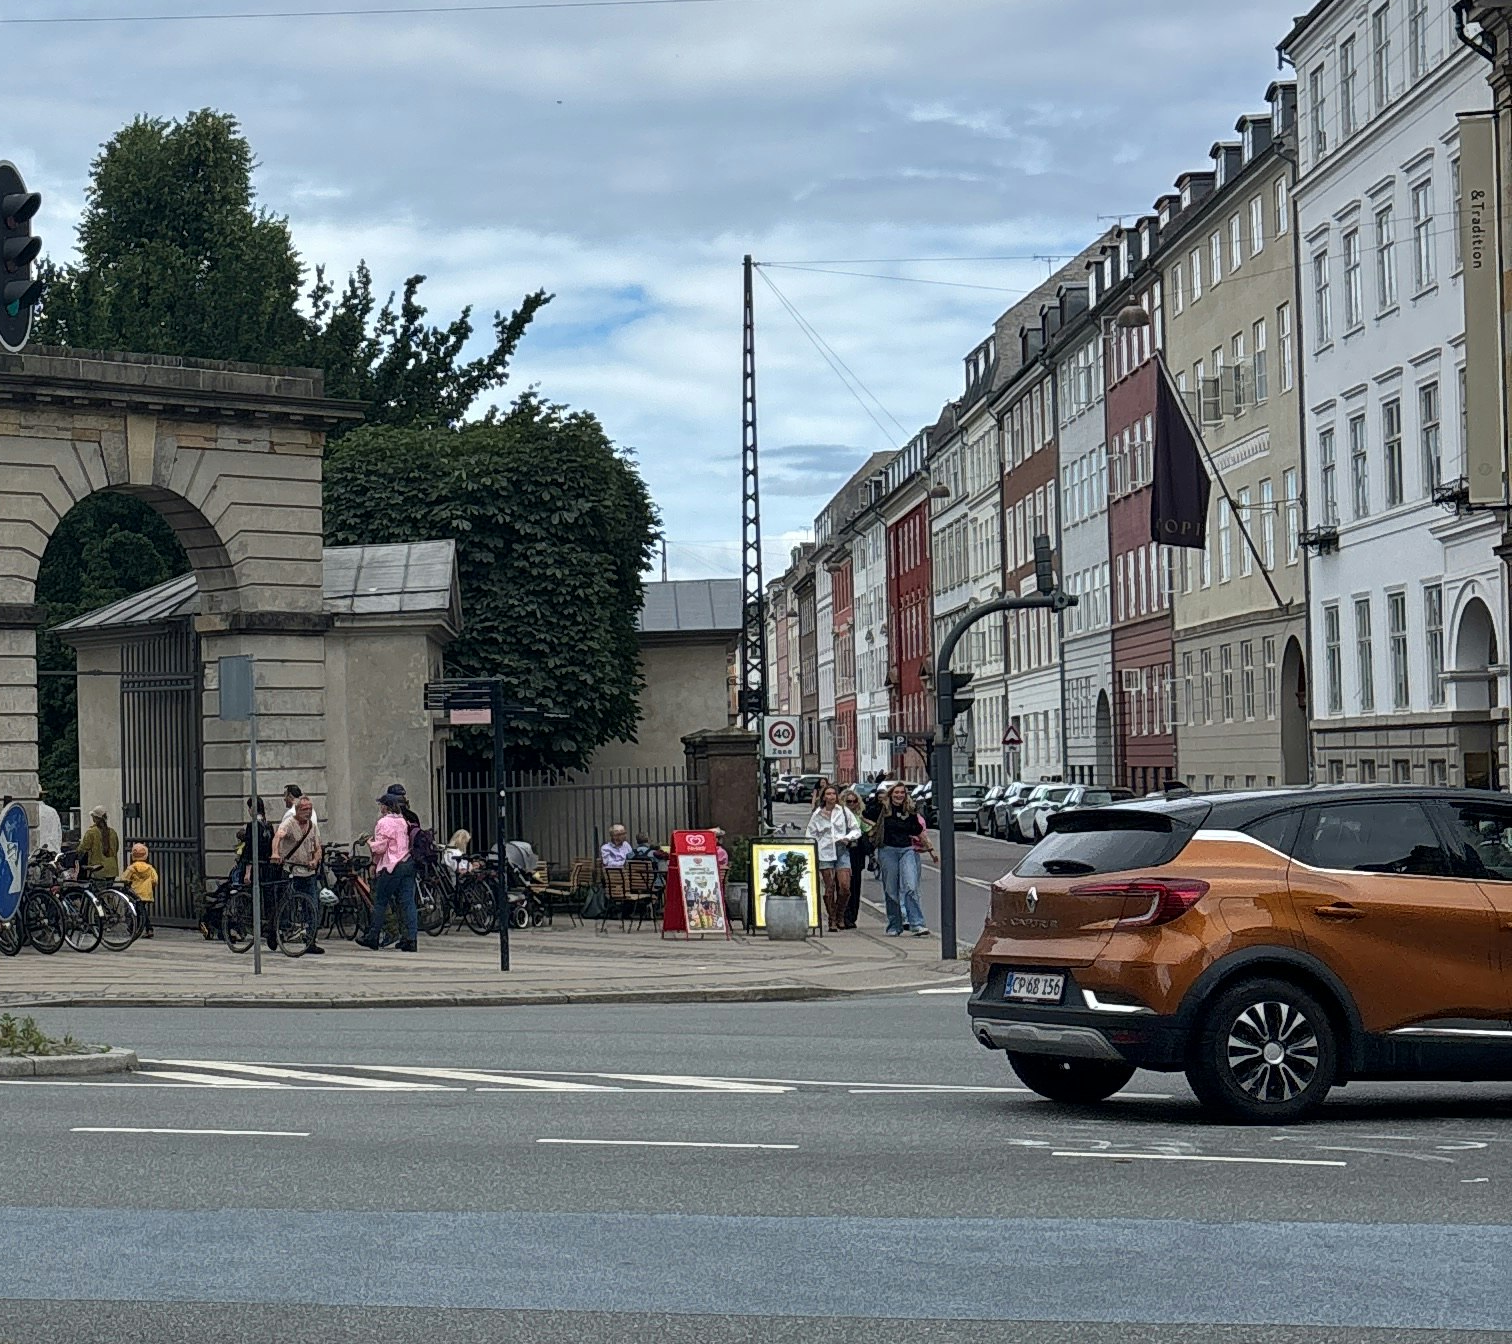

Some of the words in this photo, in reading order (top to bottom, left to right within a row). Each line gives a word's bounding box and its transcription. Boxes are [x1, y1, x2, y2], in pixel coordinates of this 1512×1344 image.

[1470, 189, 1486, 270] &Tradition
[774, 728, 791, 739] 40
[1012, 976, 1026, 994] CP
[1026, 977, 1041, 995] 68
[1041, 978, 1061, 996] 156
